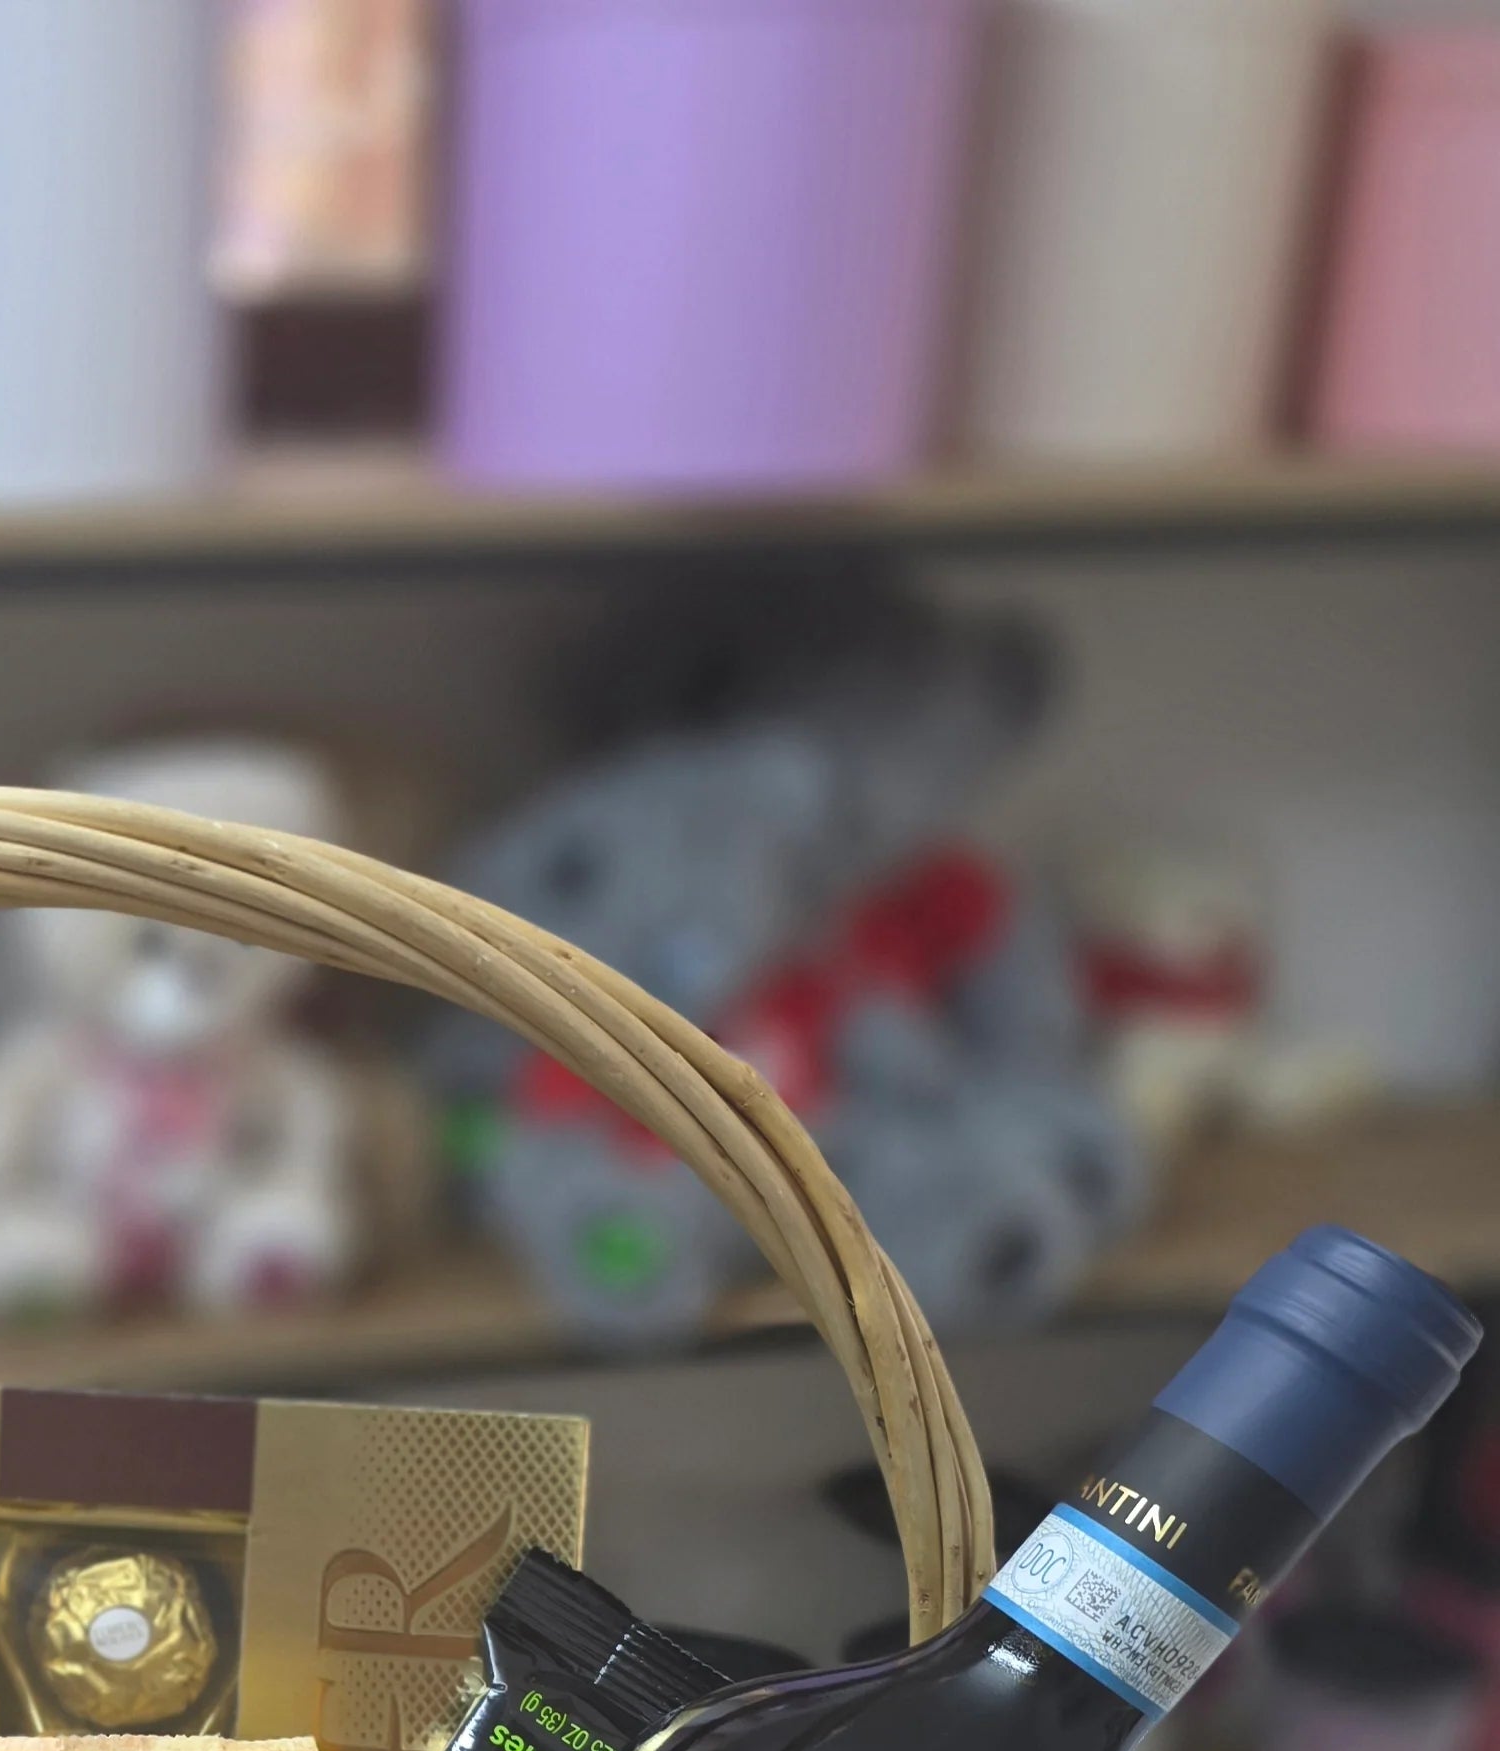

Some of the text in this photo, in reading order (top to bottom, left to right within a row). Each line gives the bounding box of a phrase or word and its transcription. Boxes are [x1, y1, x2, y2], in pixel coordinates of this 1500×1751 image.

[1018, 1542, 1067, 1585] DOC
[520, 1690, 543, 1712] g)
[536, 1705, 567, 1734] (35
[561, 1723, 590, 1750] OZ
